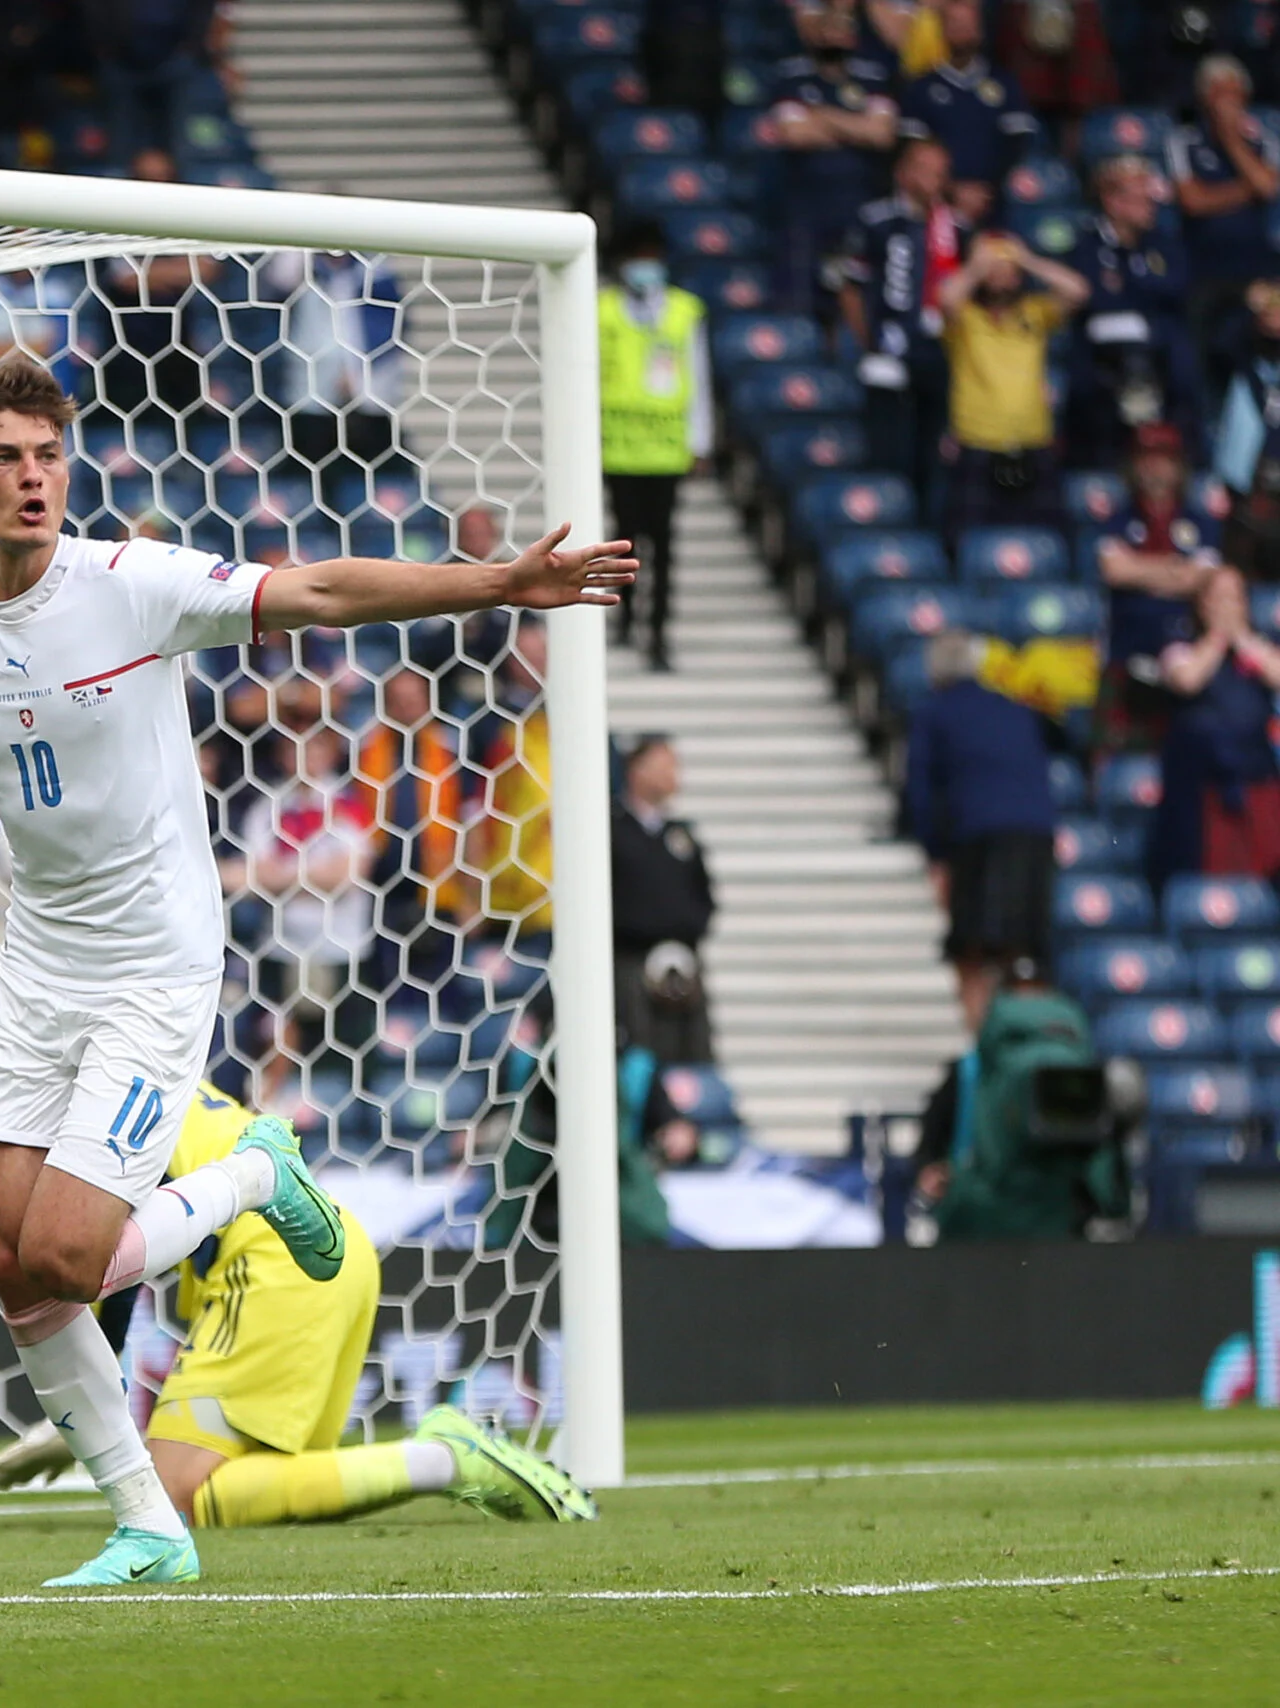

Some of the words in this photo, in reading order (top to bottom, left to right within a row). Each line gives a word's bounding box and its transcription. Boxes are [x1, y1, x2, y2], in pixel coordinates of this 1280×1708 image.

[18, 687, 53, 700] REPUBLIC
[10, 740, 62, 811] 10
[108, 1076, 163, 1150] 10
